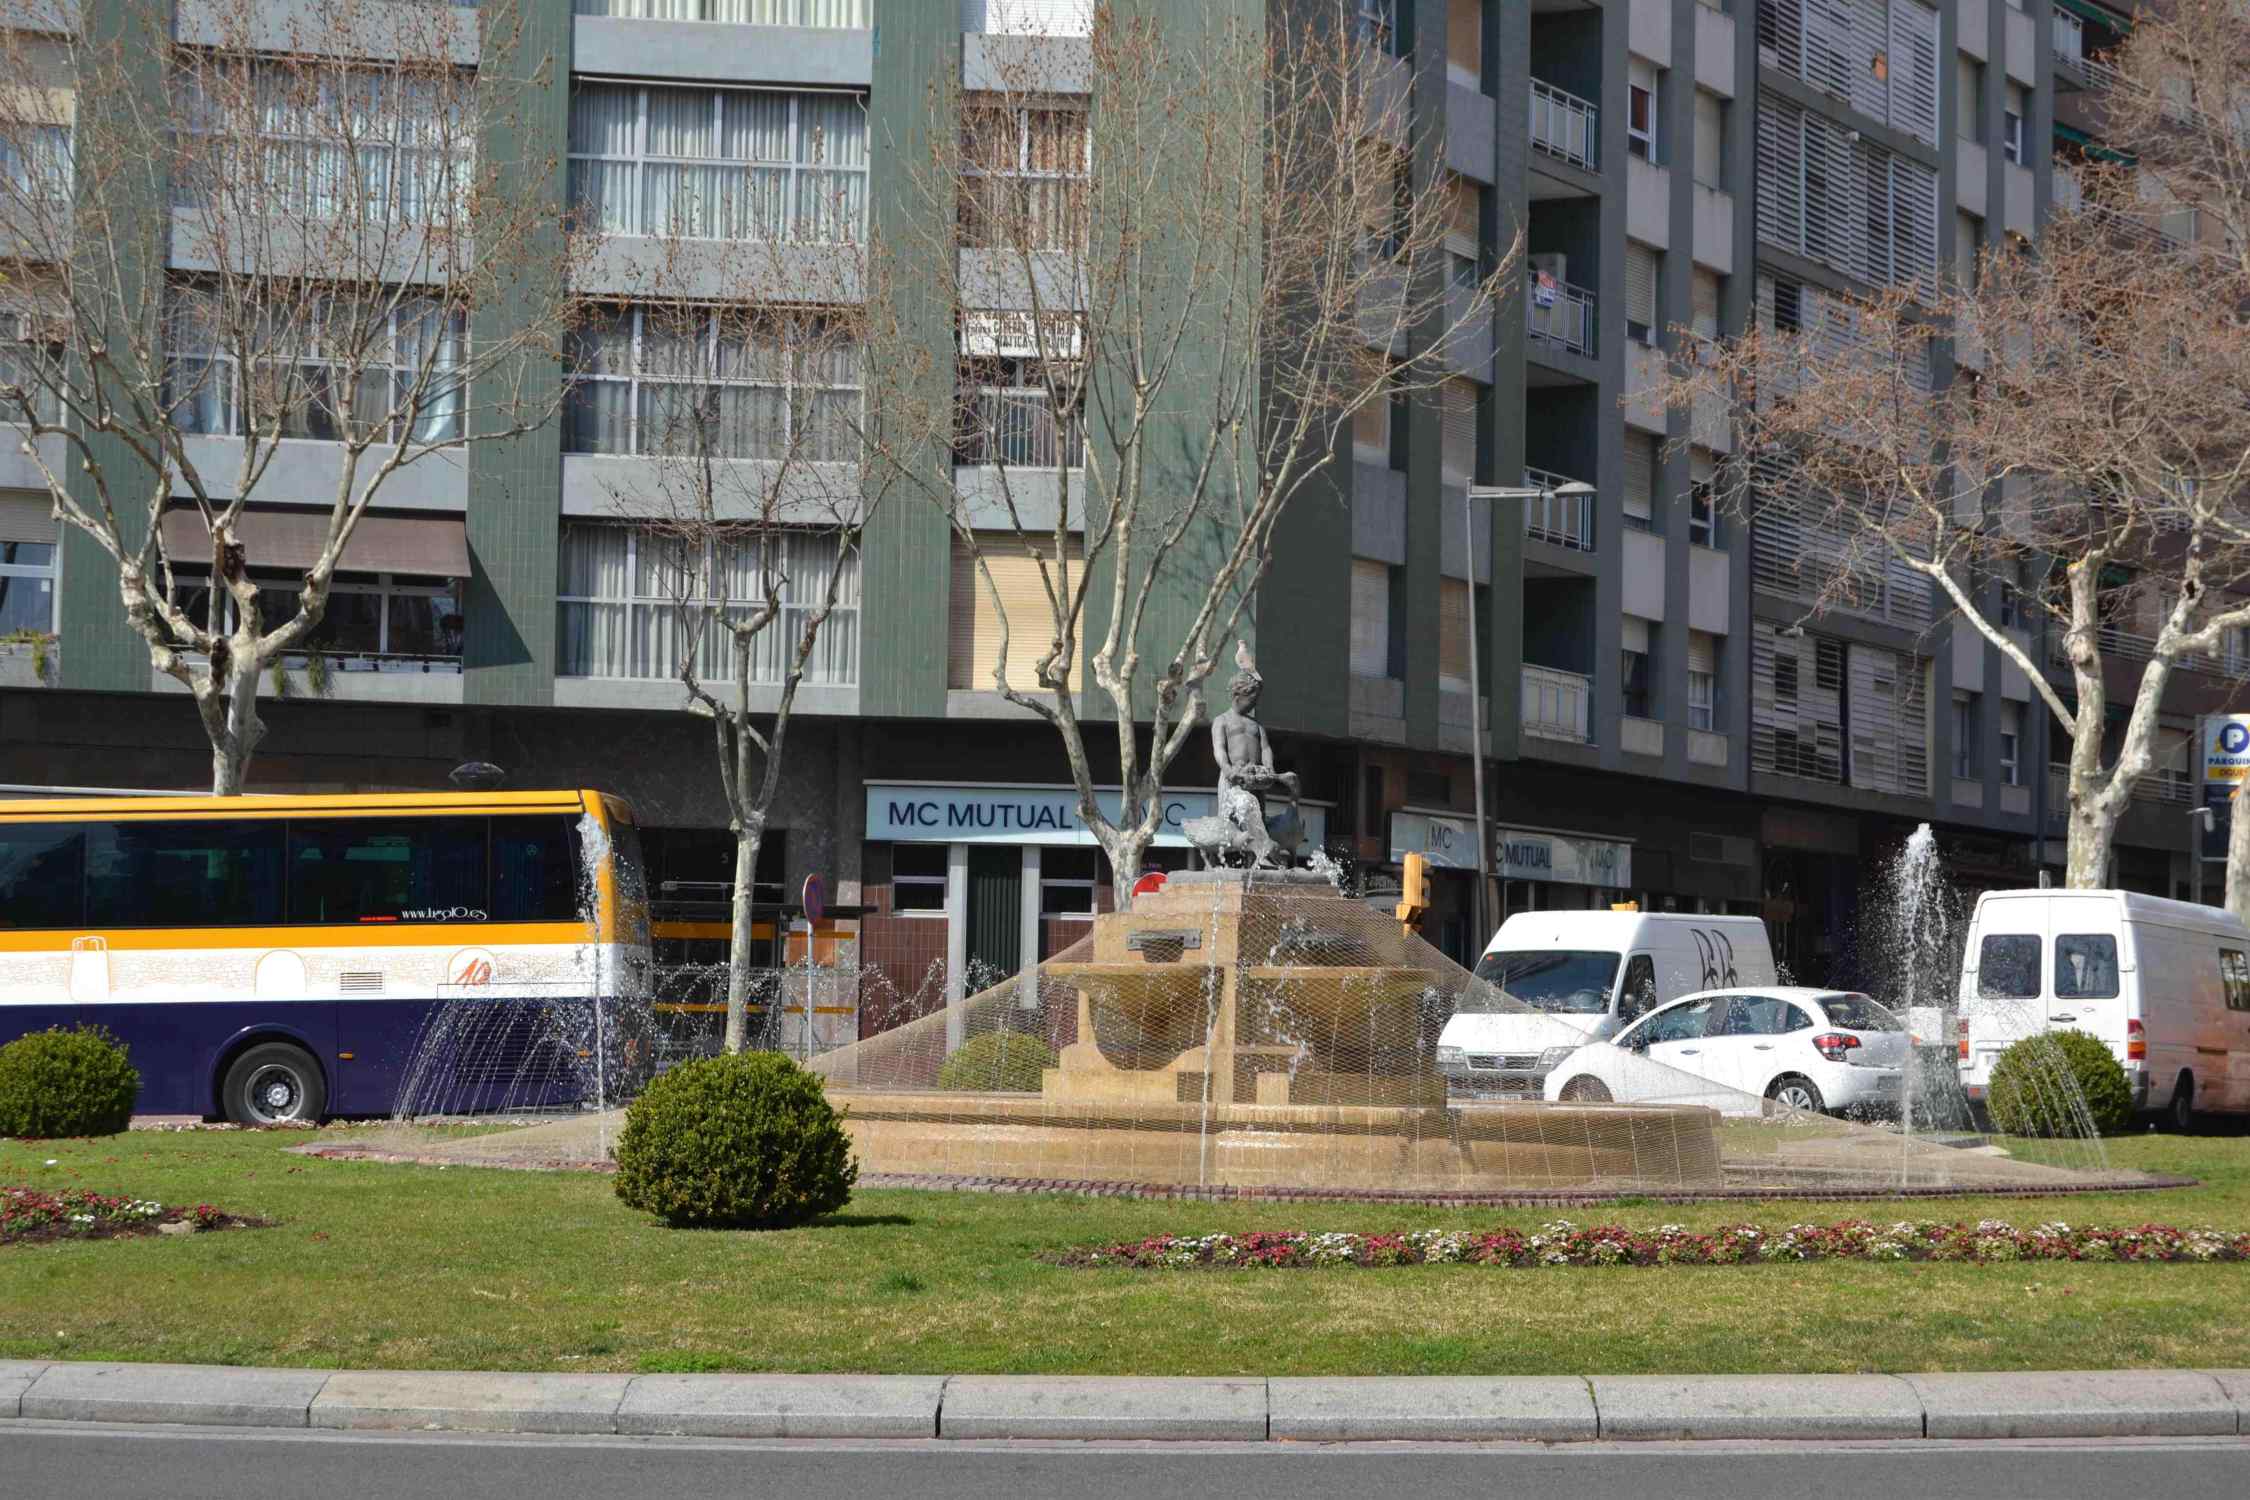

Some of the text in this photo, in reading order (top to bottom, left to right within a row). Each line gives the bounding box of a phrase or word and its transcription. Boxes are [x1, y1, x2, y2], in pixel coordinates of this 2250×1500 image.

[889, 802, 1072, 829] MC MUTUAL
[1431, 825, 1453, 849] MC
[1505, 842, 1552, 869] MUTUAL
